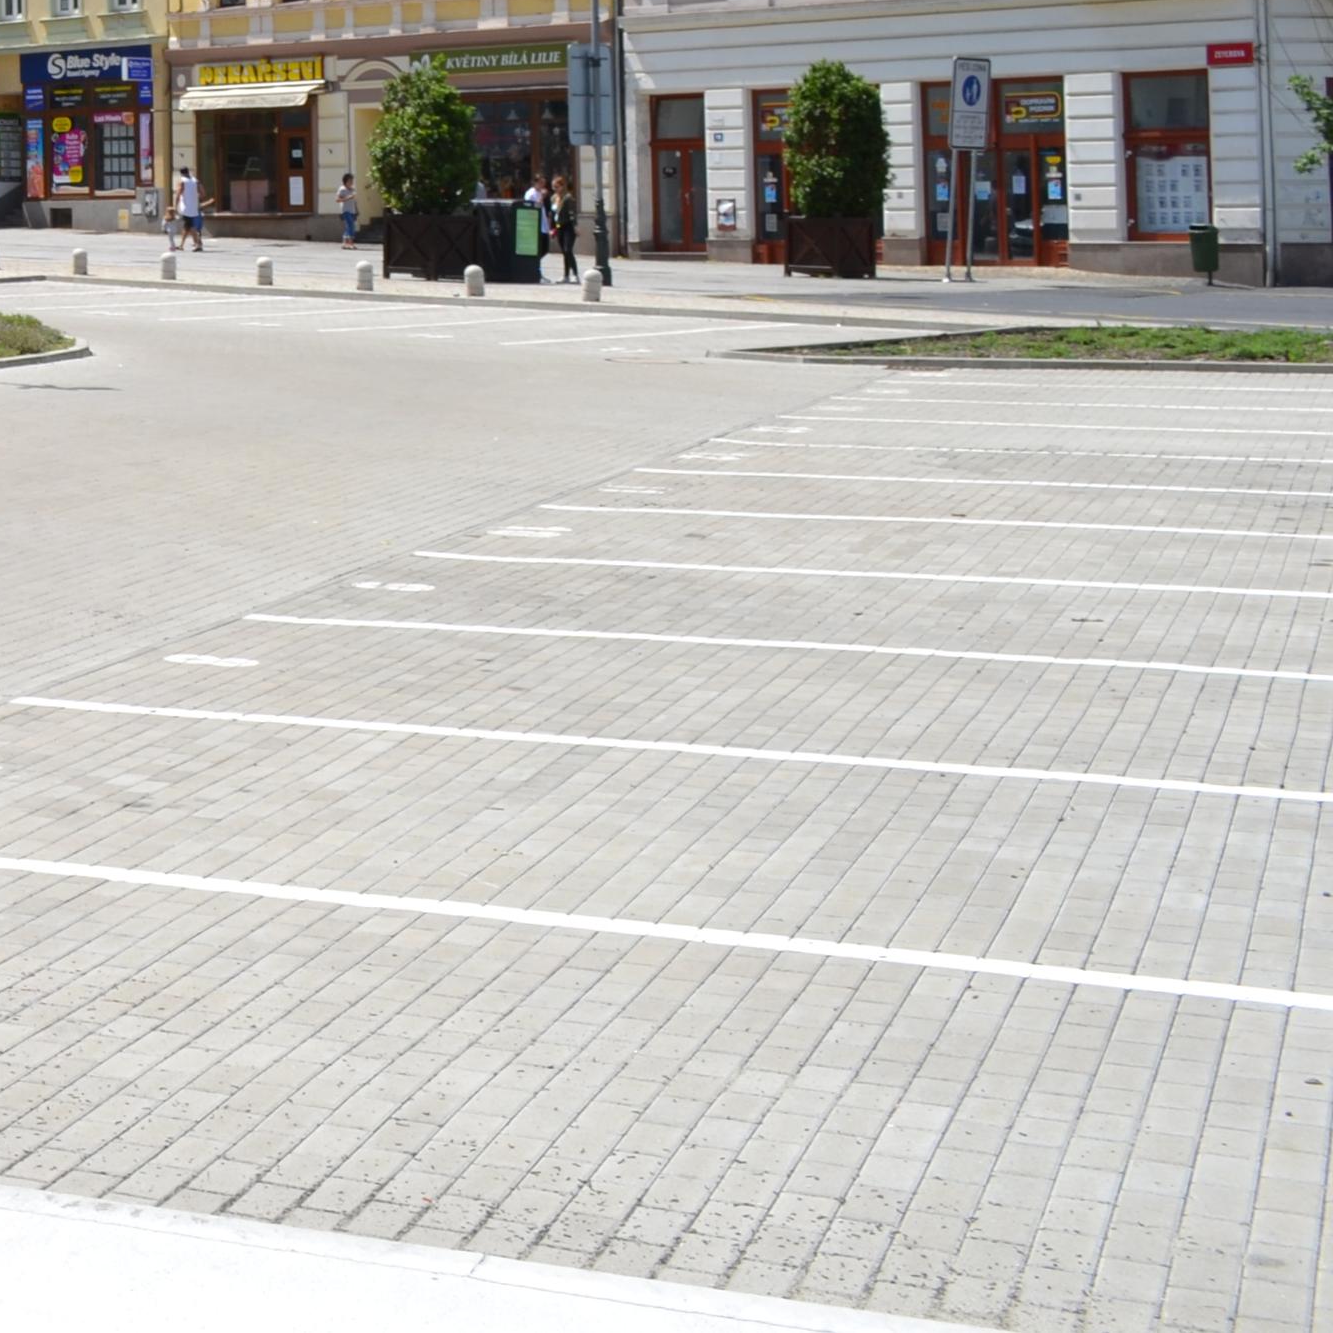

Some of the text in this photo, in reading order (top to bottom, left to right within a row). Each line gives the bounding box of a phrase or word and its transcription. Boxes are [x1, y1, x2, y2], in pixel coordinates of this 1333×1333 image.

[66, 54, 91, 70] Blue
[92, 52, 122, 71] Style
[445, 51, 562, 69] KVĚTINY BÍLÁ LILIE
[199, 55, 324, 86] PEKAŘSTVÍ
